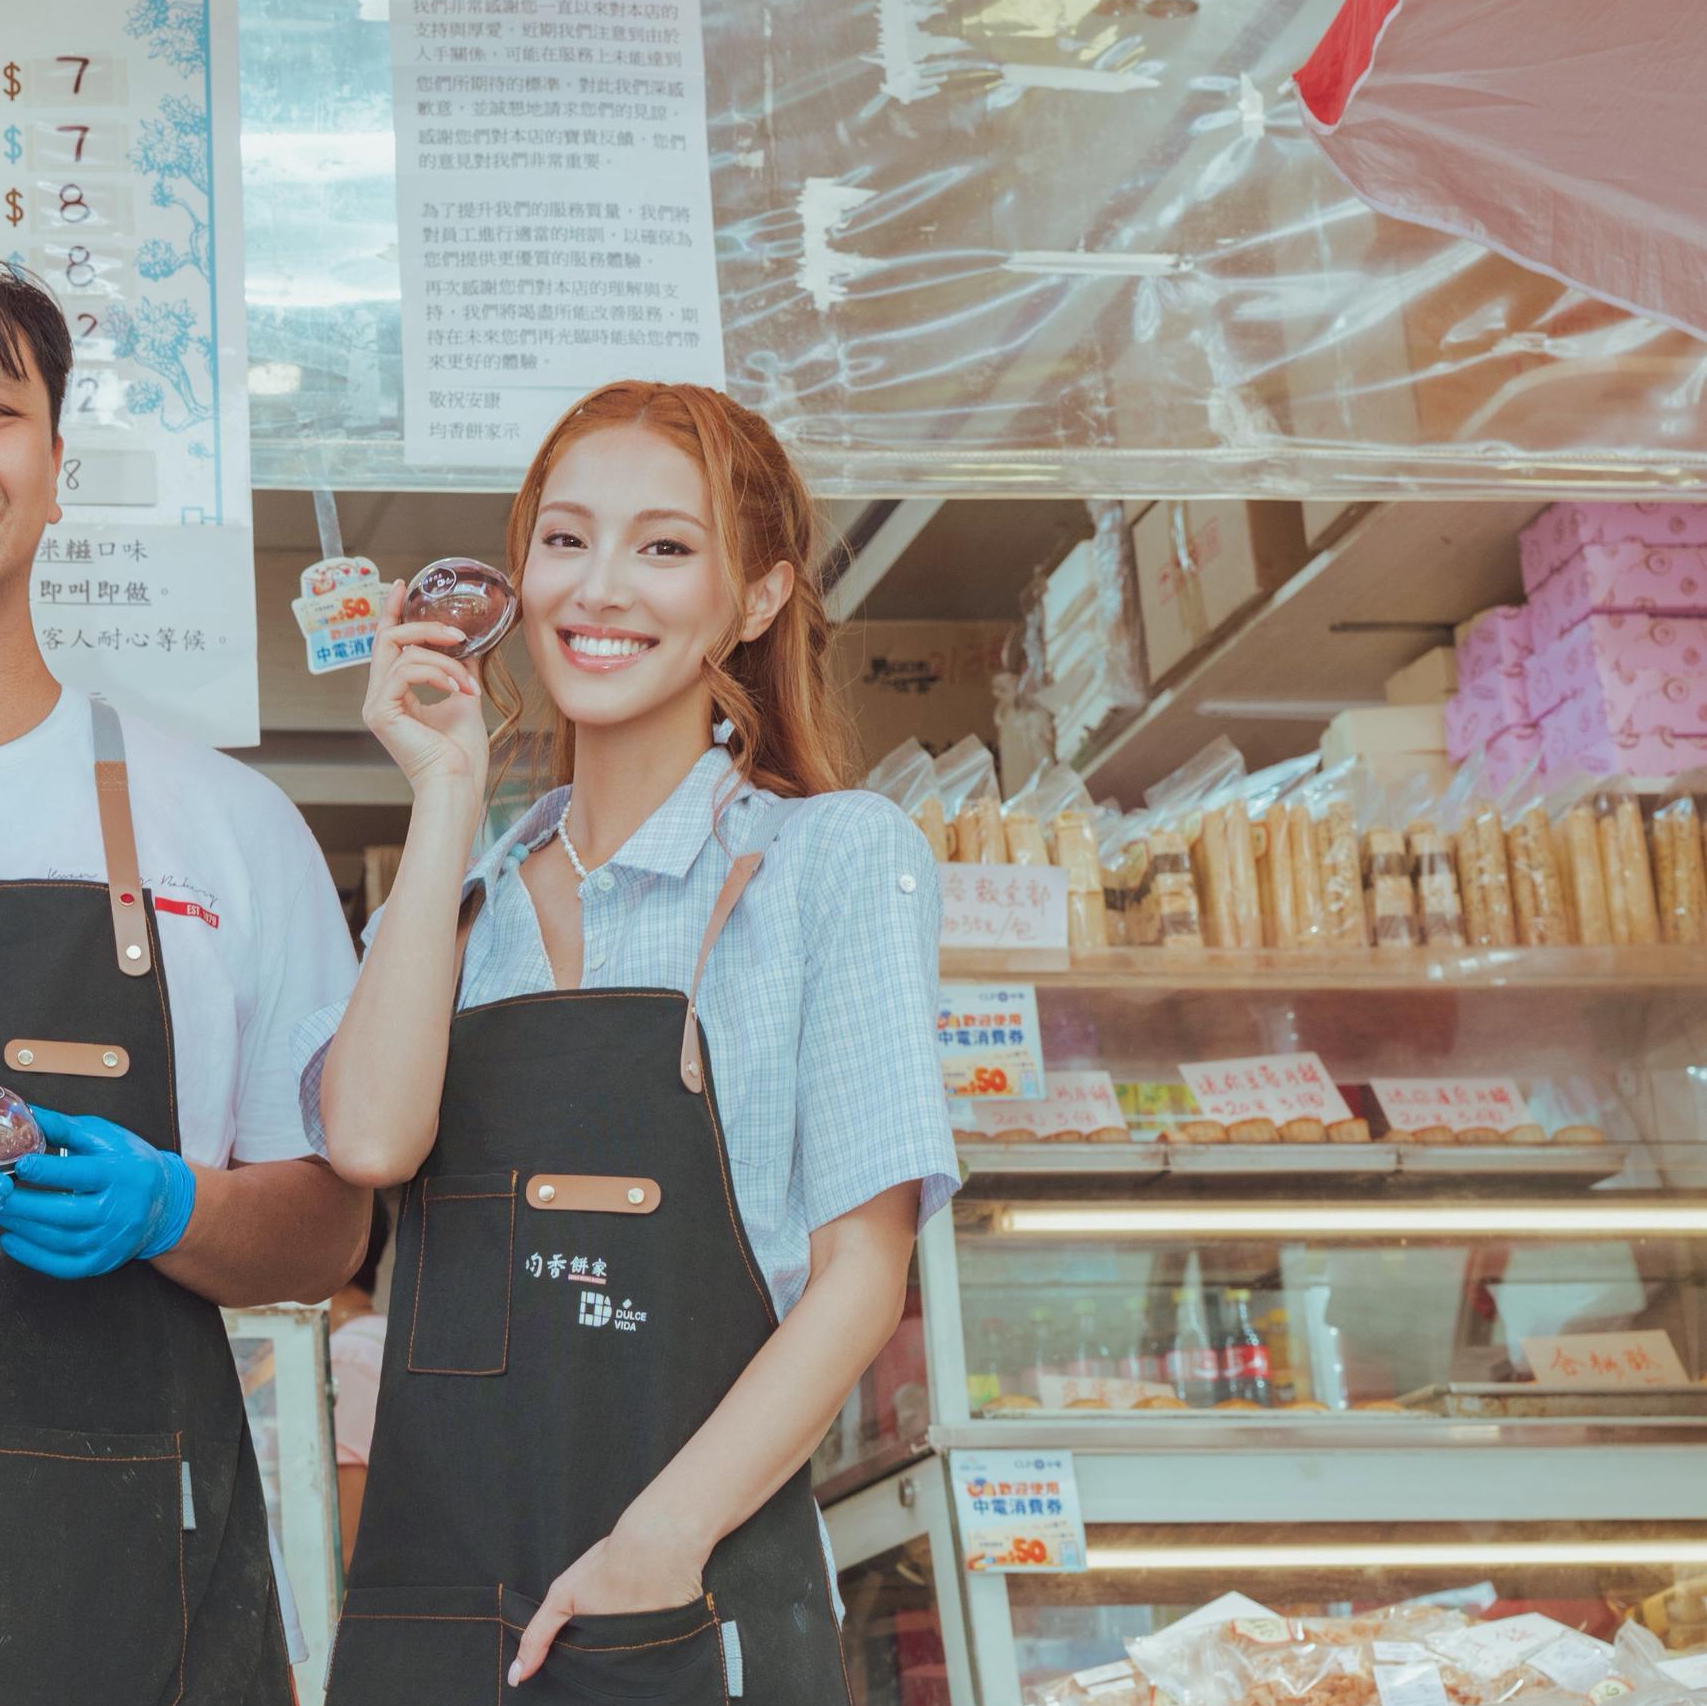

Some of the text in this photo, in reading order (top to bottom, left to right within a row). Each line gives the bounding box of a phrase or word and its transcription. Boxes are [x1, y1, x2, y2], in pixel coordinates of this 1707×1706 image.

[525, 1251, 607, 1278] 均香餅家
[615, 1309, 647, 1322] DULCE
[614, 1320, 637, 1332] VIDA
